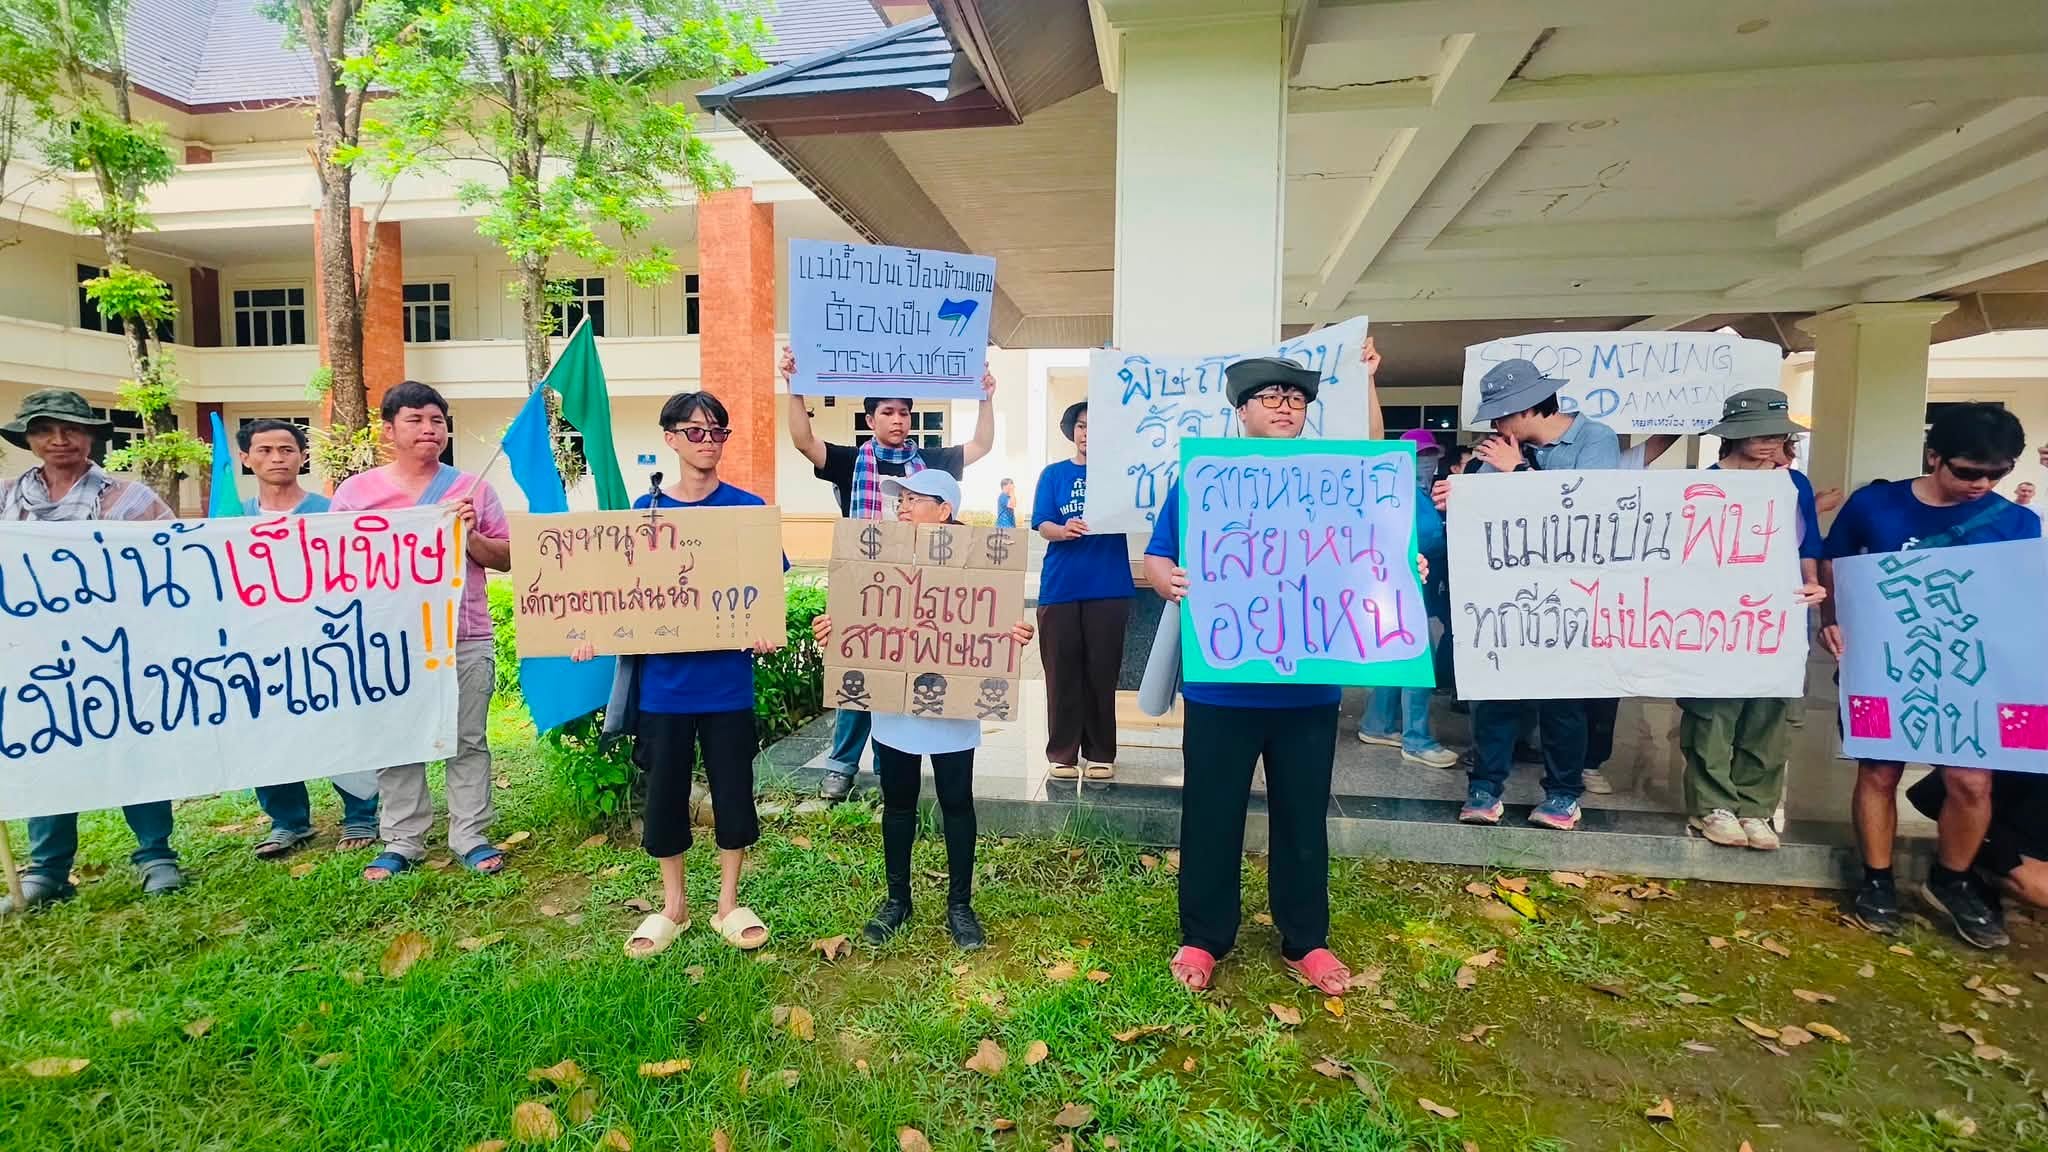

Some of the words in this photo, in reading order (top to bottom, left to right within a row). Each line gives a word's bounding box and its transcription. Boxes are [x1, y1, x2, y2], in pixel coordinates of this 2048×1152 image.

[825, 291, 931, 336] ต้องเป็น
[1588, 342, 1734, 379] MINING
[859, 566, 998, 628] กำไรเขา
[1210, 574, 1415, 672] อยู่ไหน
[1899, 683, 1988, 758] ตีน
